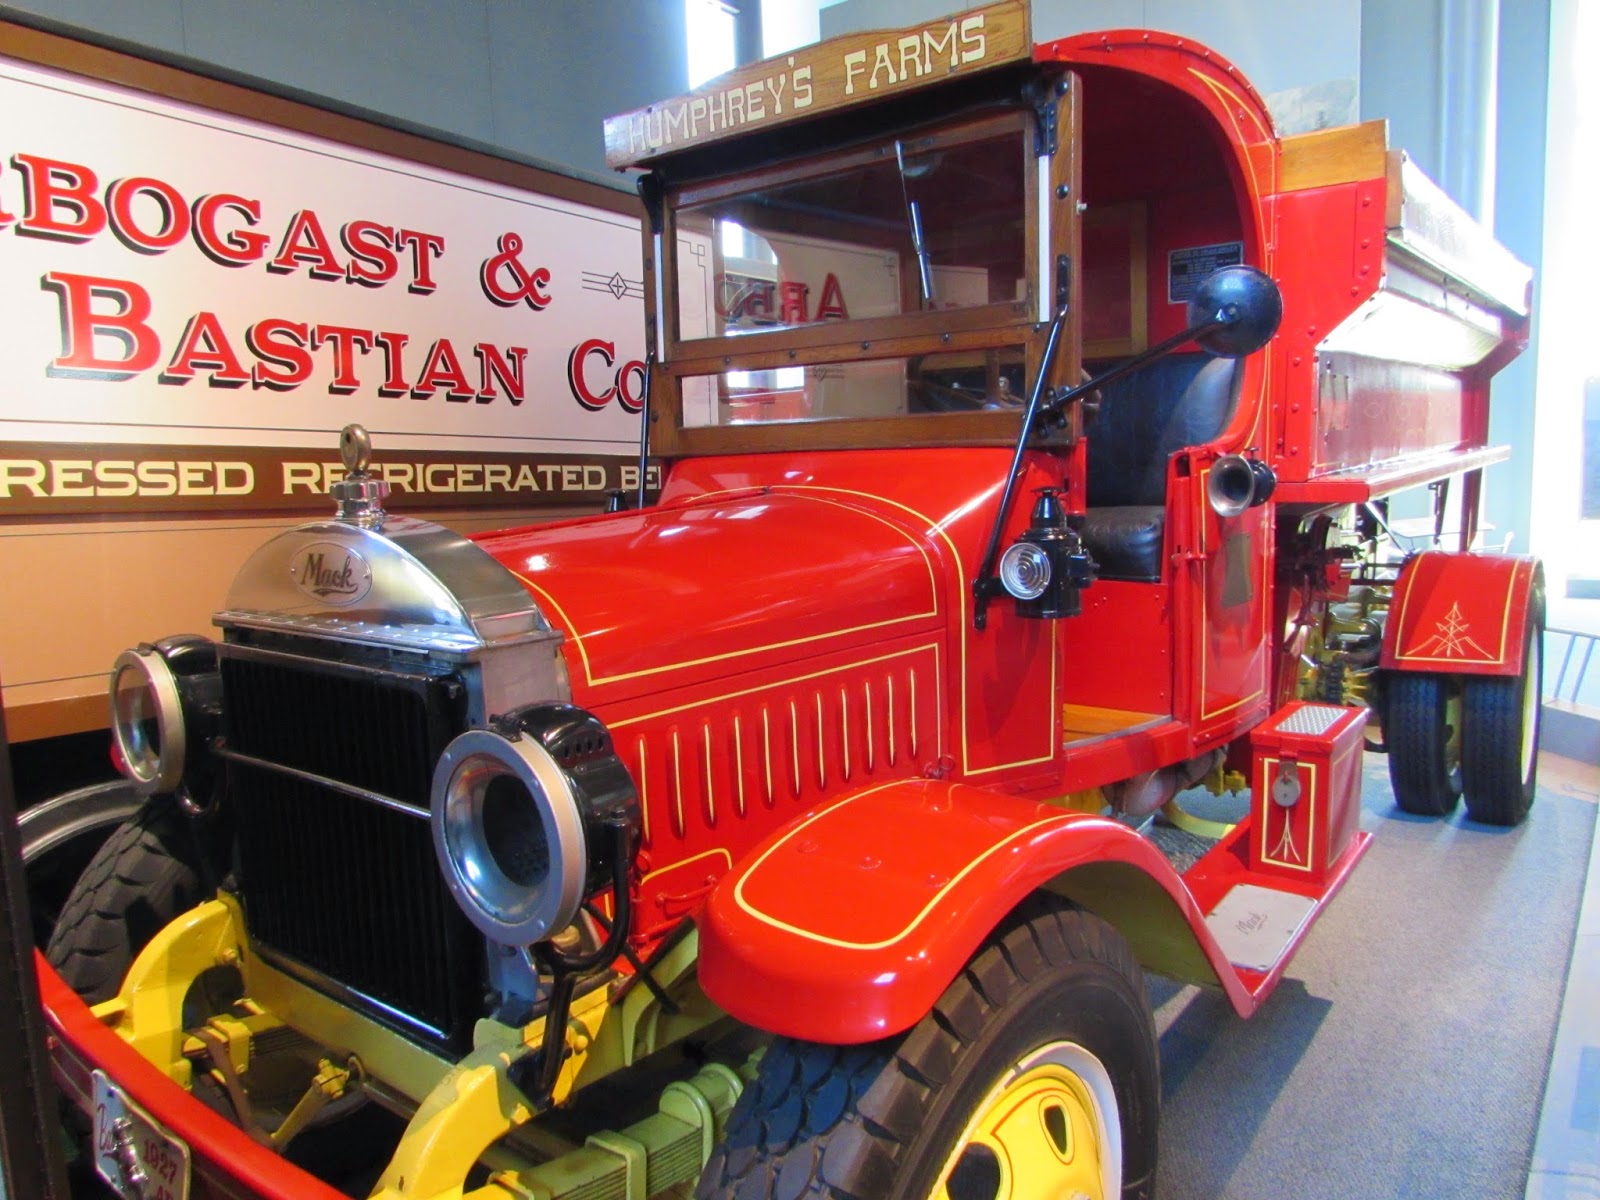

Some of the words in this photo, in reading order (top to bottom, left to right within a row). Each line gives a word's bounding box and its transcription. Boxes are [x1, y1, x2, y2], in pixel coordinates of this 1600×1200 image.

[628, 56, 813, 153] HUMPHREY'S
[844, 15, 986, 95] FARMS
[0, 153, 444, 295] BOGAST
[481, 231, 553, 310] &
[41, 271, 528, 405] BASTIAN
[281, 462, 606, 495] RERIGERATED
[300, 552, 359, 596] Mack
[1235, 911, 1267, 935] Mack
[143, 1139, 177, 1183] 1927
